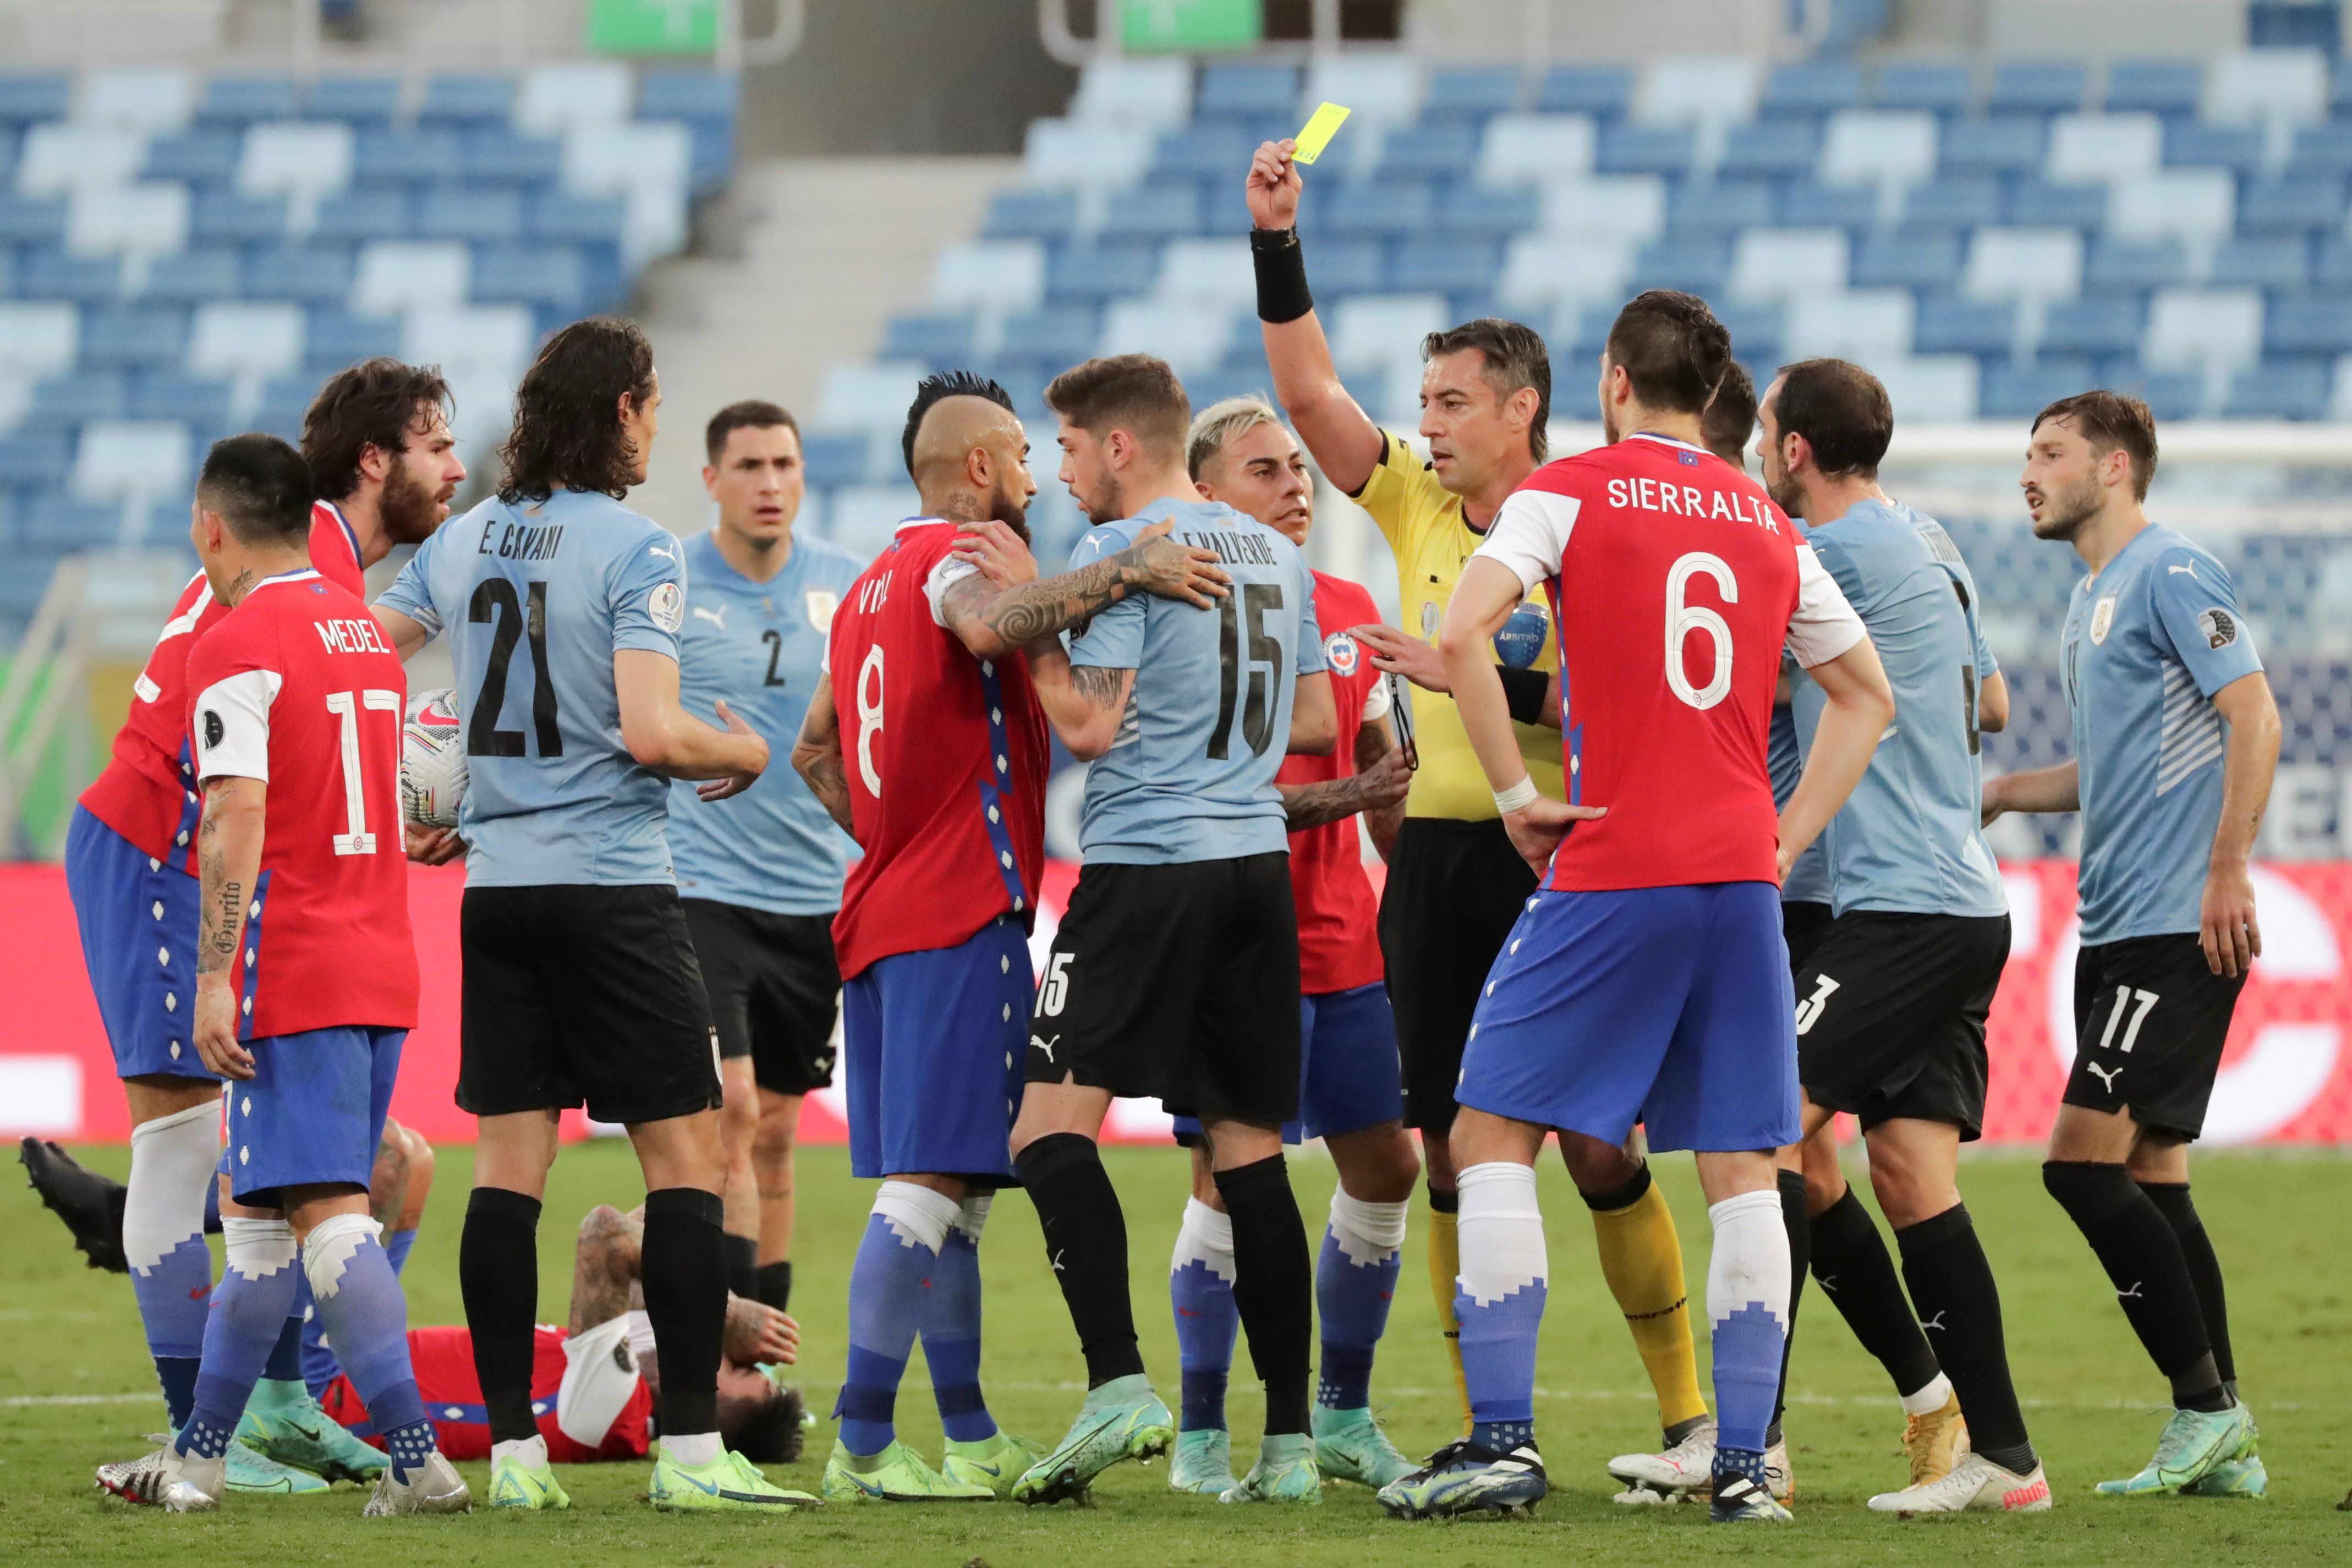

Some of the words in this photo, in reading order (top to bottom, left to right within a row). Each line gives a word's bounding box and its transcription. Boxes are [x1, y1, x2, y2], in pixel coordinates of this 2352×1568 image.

[1608, 478, 1780, 536] SIERRALTA
[479, 520, 496, 555] E.
[498, 523, 564, 560] CAVANI
[1197, 531, 1277, 566] VALVERDE
[314, 619, 390, 654] MEDEL
[762, 629, 786, 687] 2
[1499, 631, 1539, 643] ÁRBITRO
[1665, 551, 1739, 710] 6
[468, 578, 563, 758] 21
[1207, 583, 1284, 760] 15
[326, 689, 407, 856] 17
[1034, 953, 1075, 1017] 15
[1796, 973, 1840, 1035] 3
[2099, 985, 2159, 1053] 17
